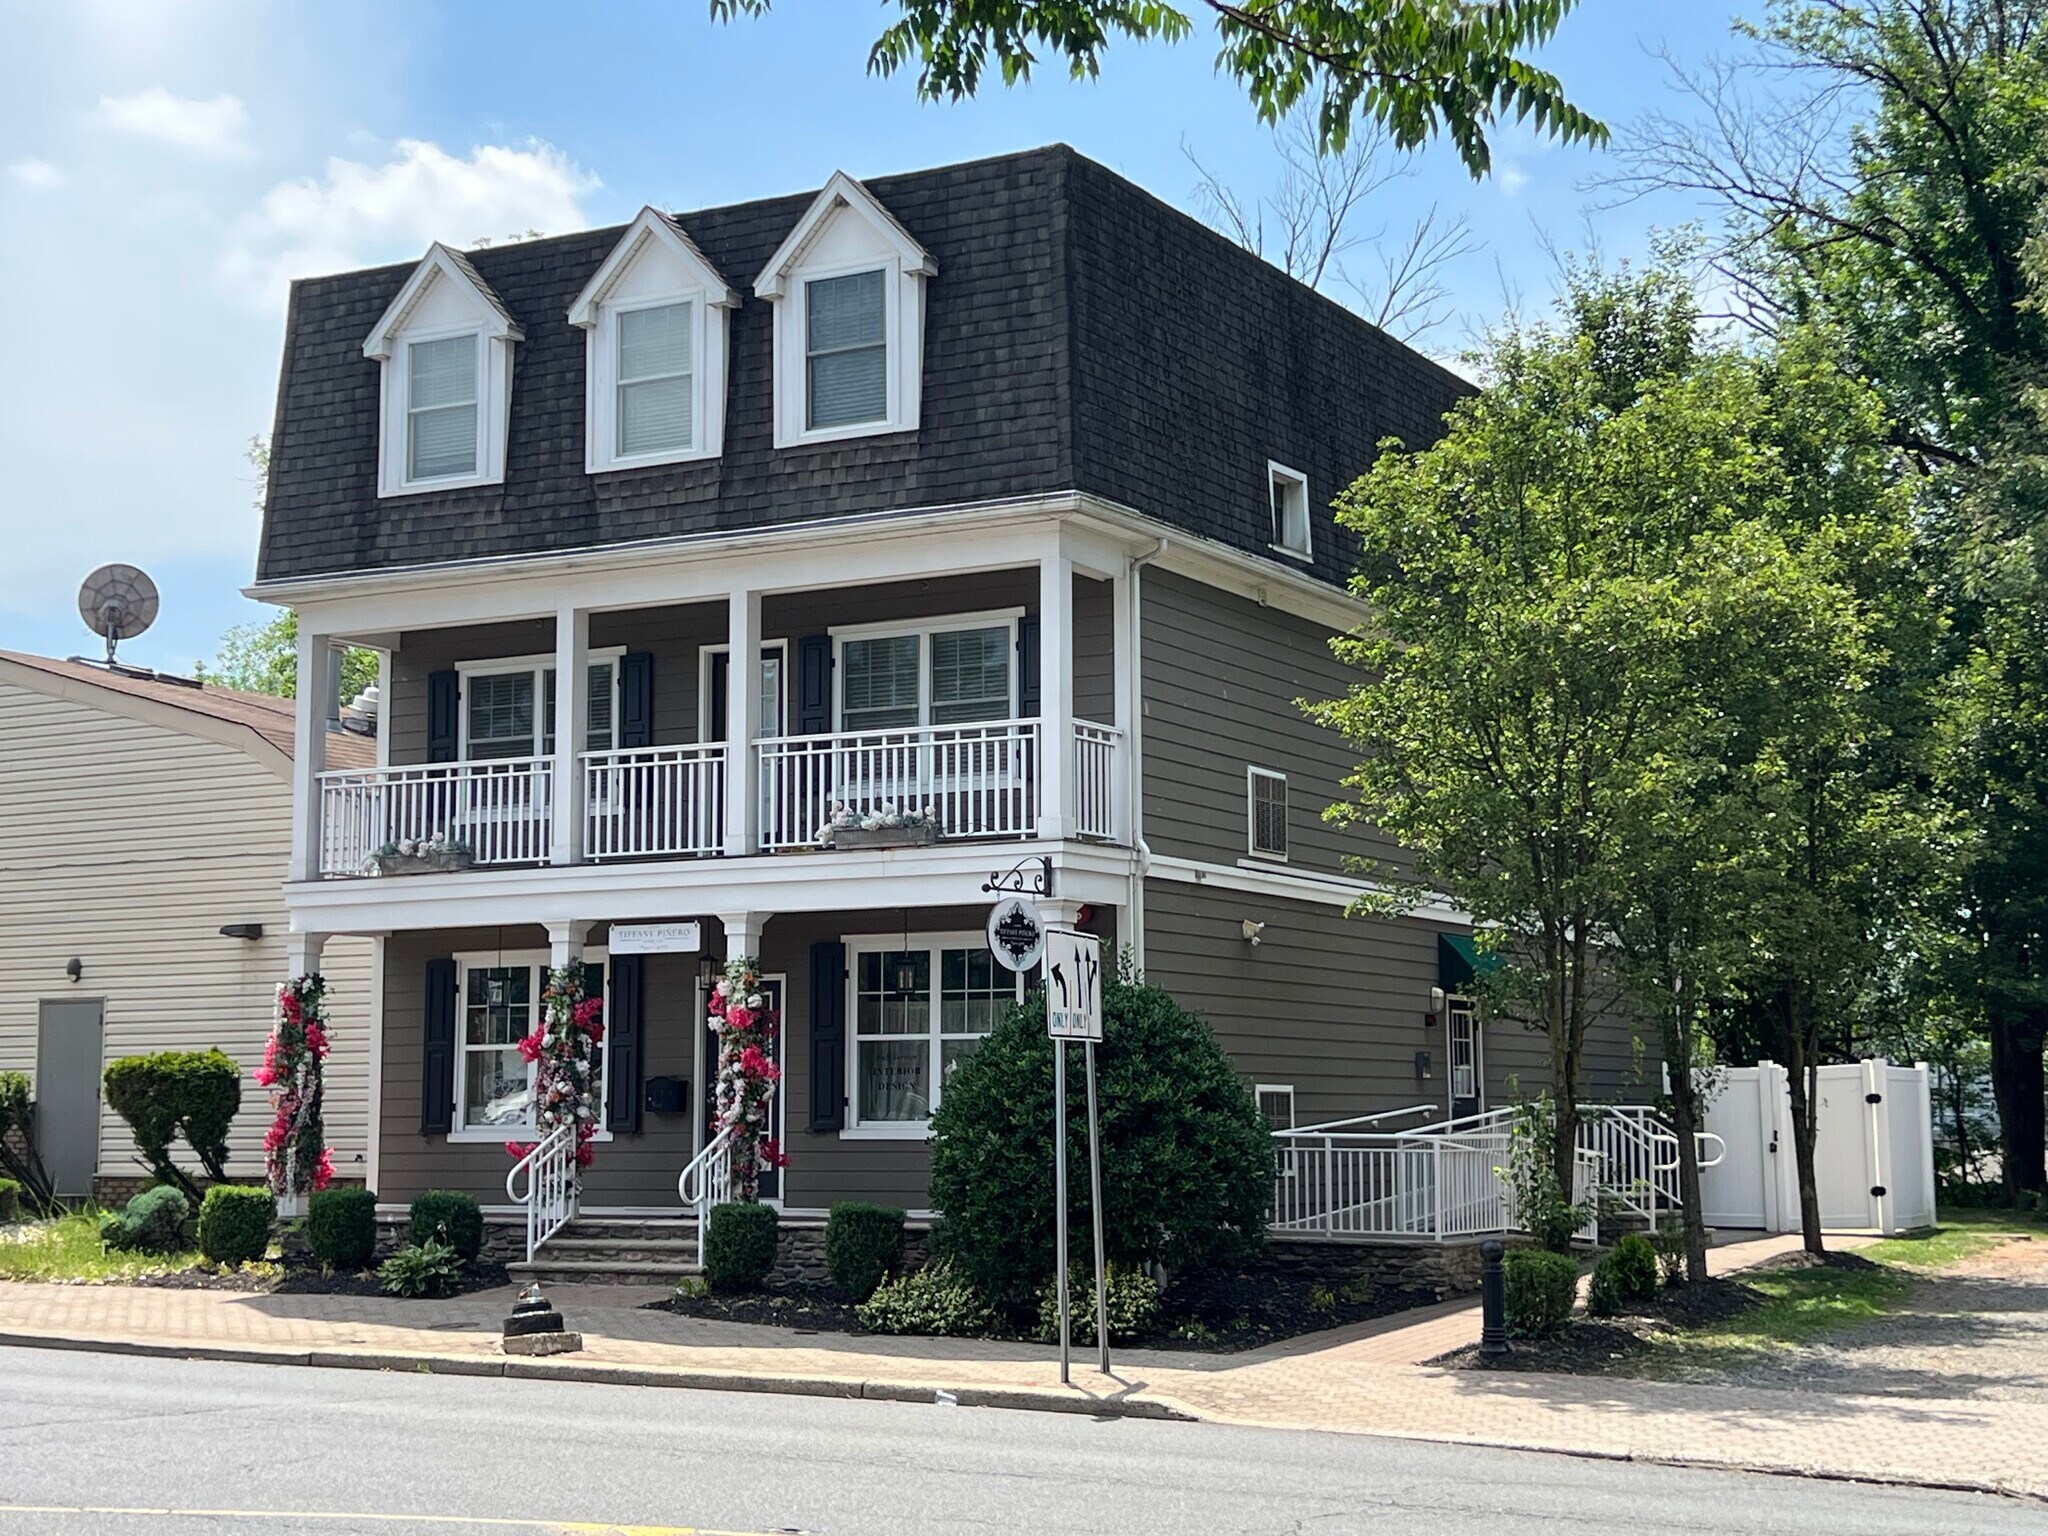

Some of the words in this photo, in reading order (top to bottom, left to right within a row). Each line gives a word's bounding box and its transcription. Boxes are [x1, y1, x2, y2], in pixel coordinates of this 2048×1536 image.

[619, 930, 654, 939] TIFFANY
[1052, 1011, 1069, 1028] ONLY
[1072, 1012, 1087, 1029] ONLY
[873, 1067, 921, 1076] INTERIOR
[878, 1081, 916, 1091] DESIGN
